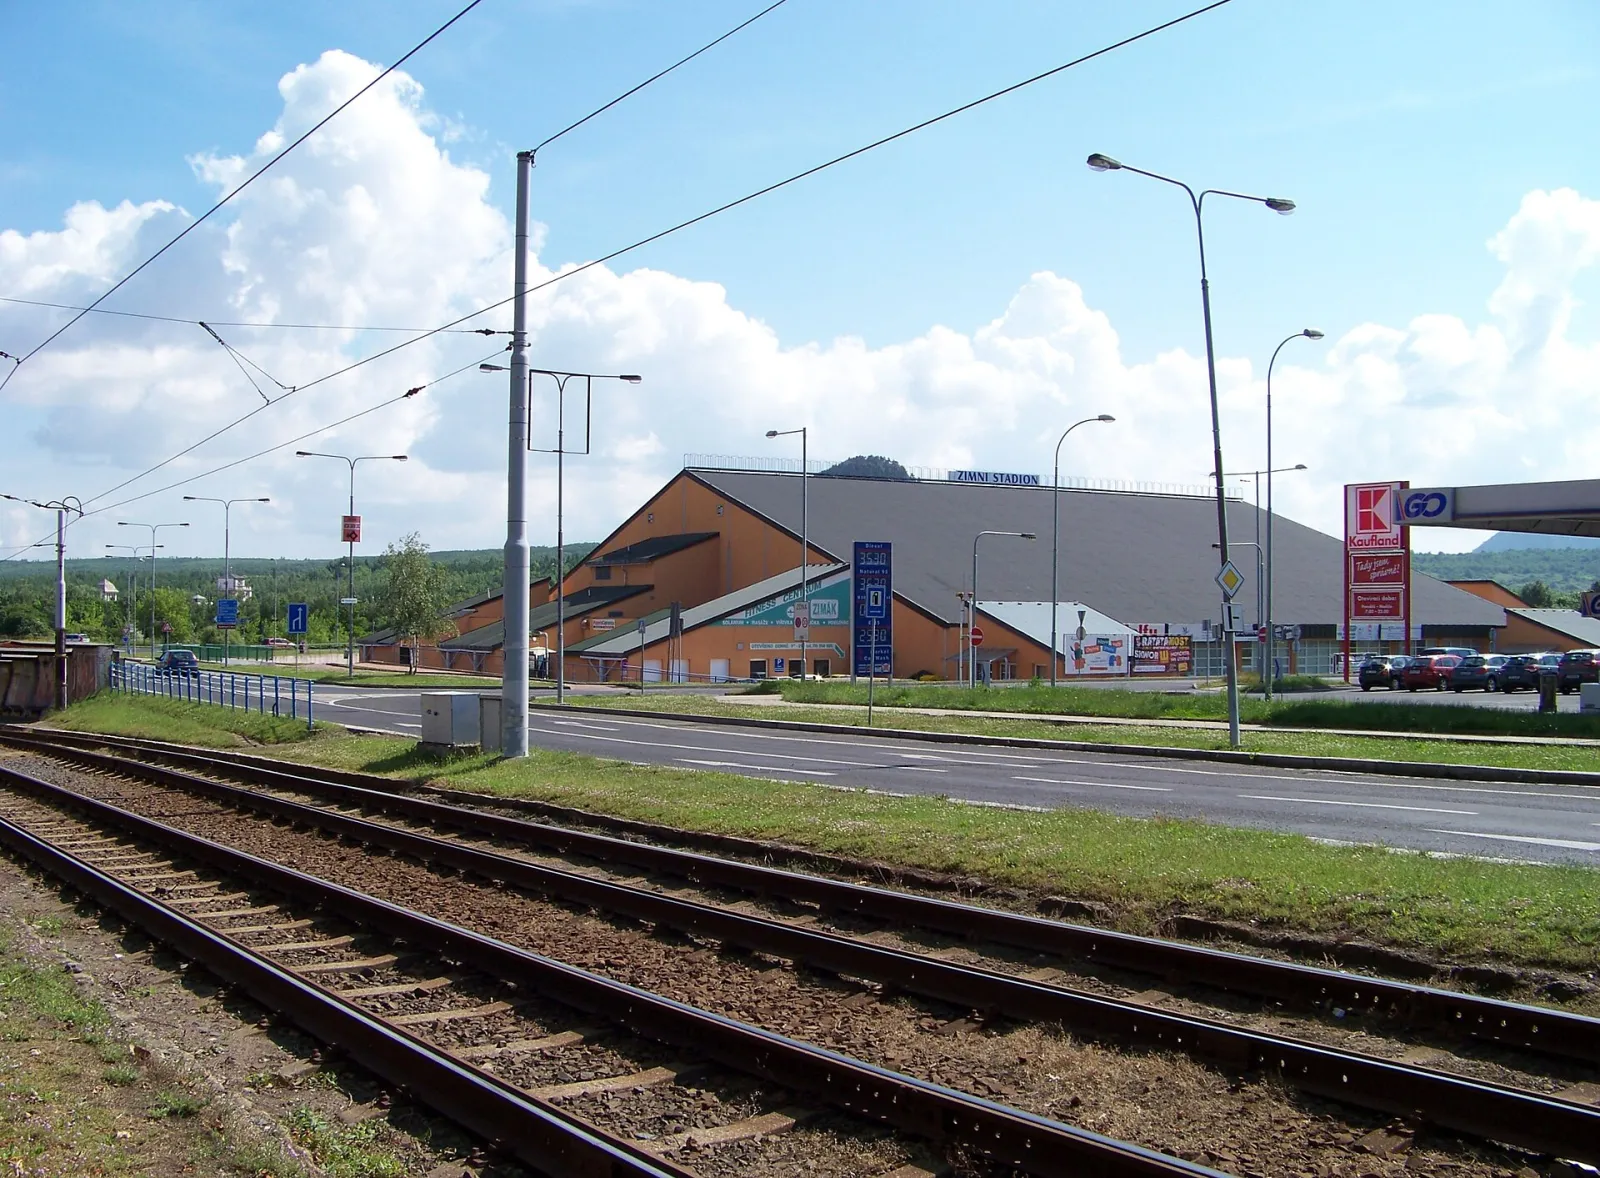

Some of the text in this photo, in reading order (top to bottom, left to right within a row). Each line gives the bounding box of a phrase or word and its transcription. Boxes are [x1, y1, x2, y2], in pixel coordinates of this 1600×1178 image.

[993, 472, 1038, 485] STADION
[1349, 534, 1399, 547] Kaufland
[744, 600, 777, 618] FITNESS
